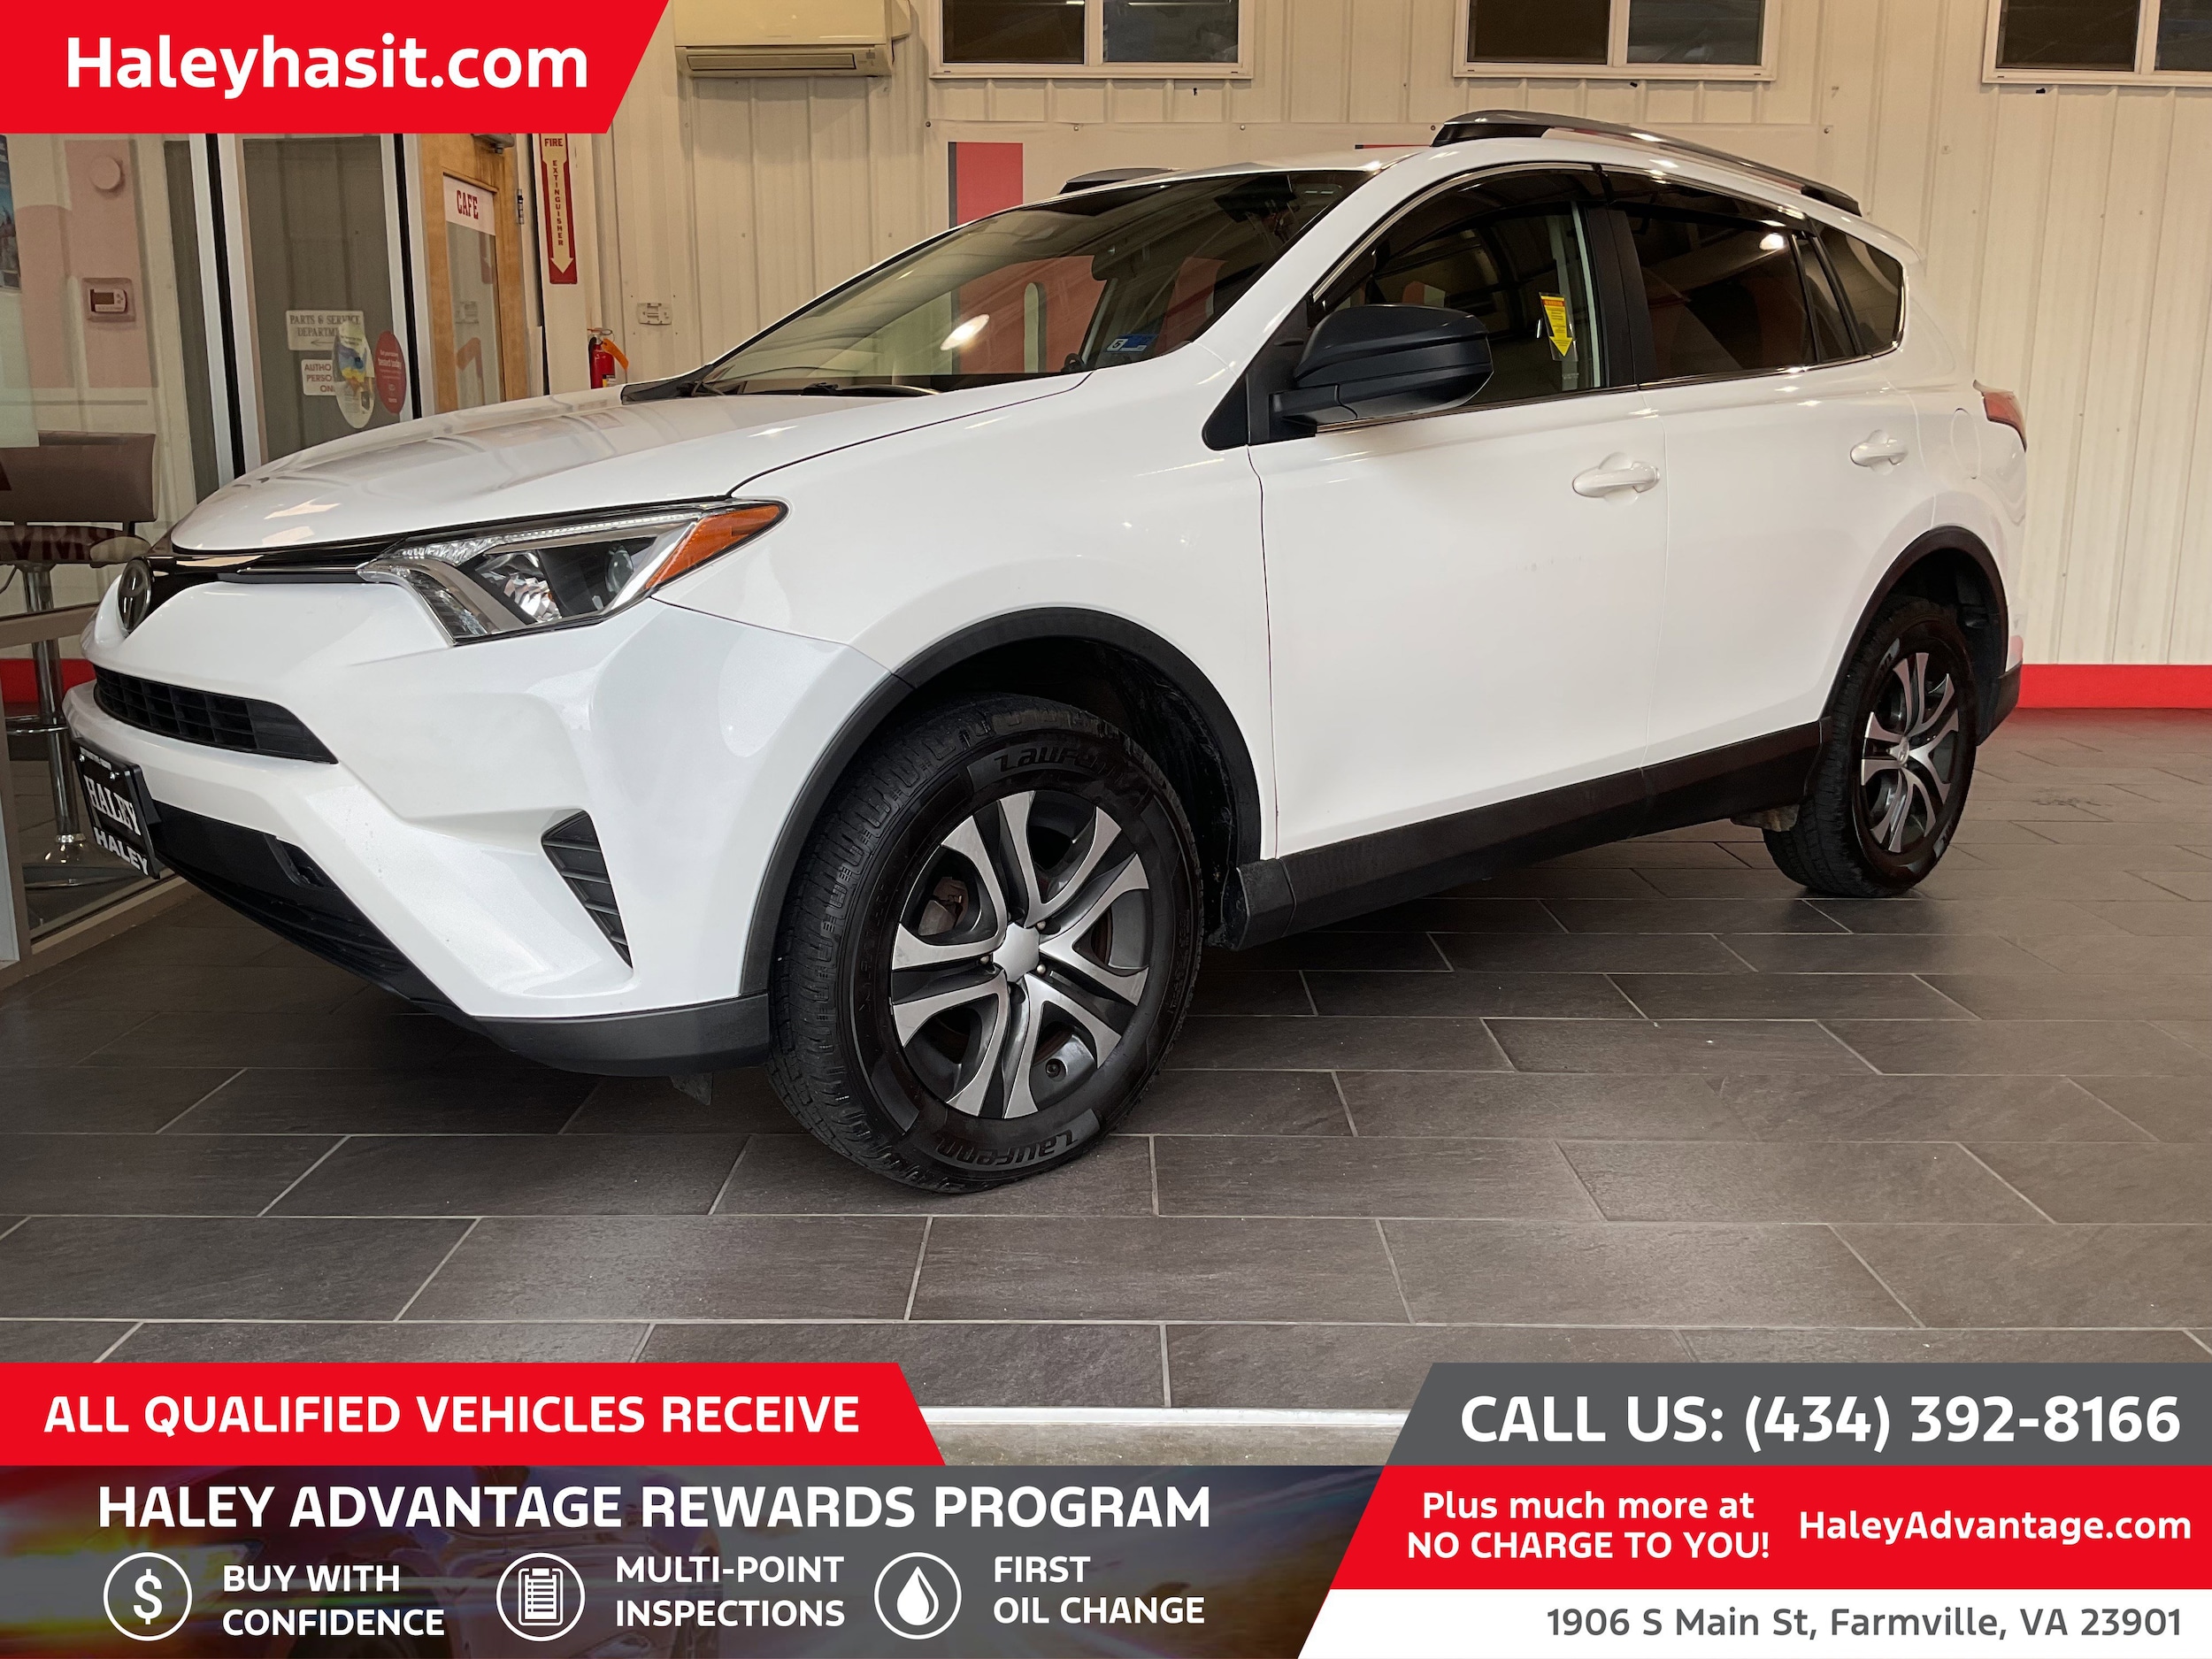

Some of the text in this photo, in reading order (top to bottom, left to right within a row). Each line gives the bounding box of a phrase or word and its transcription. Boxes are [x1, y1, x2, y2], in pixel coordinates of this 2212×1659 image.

[544, 138, 564, 147] FIRE
[457, 189, 479, 219] CAFE
[552, 159, 564, 246] EXTINGUISHER
[289, 314, 315, 325] PARTS
[318, 315, 324, 325] &
[1112, 340, 1124, 349] 5
[83, 774, 142, 836] HALEY
[93, 826, 149, 876] HALEY
